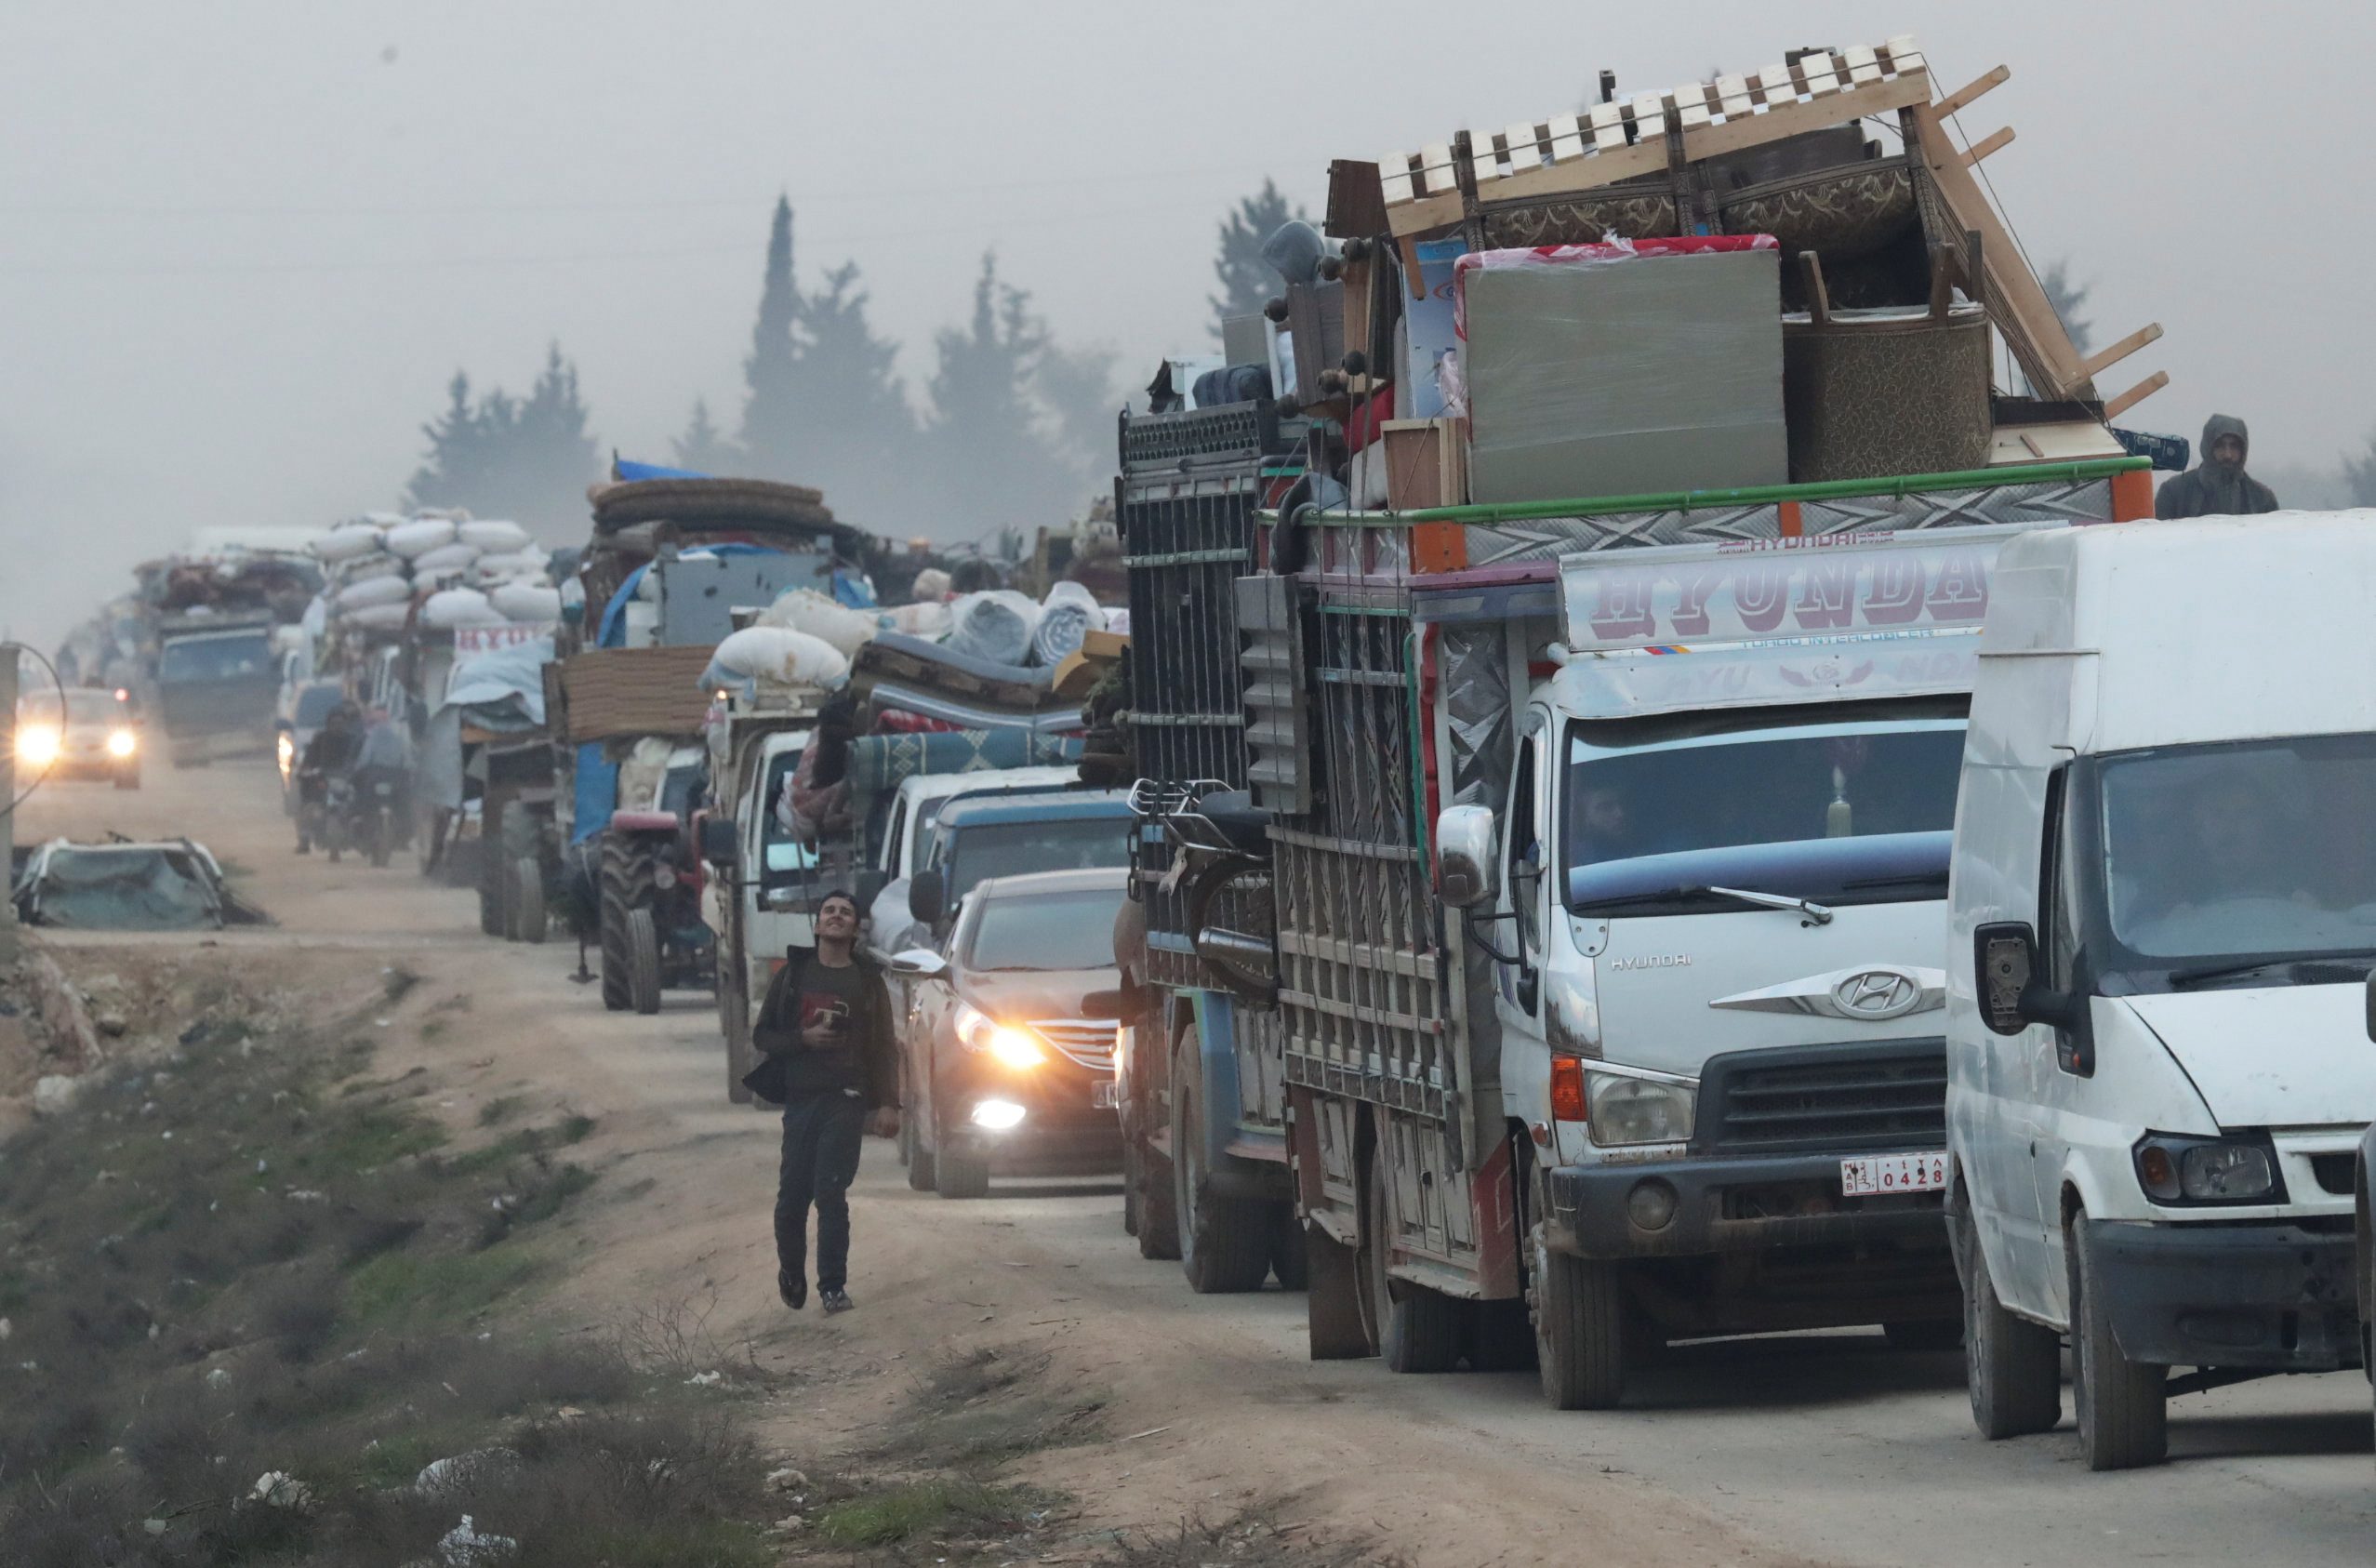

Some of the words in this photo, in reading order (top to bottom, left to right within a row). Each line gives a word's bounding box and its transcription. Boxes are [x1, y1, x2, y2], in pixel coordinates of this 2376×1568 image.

[1750, 533, 1856, 551] HYUNDAI
[1589, 553, 1989, 640] HYUNDA
[1612, 954, 1692, 971] HYUNDAI
